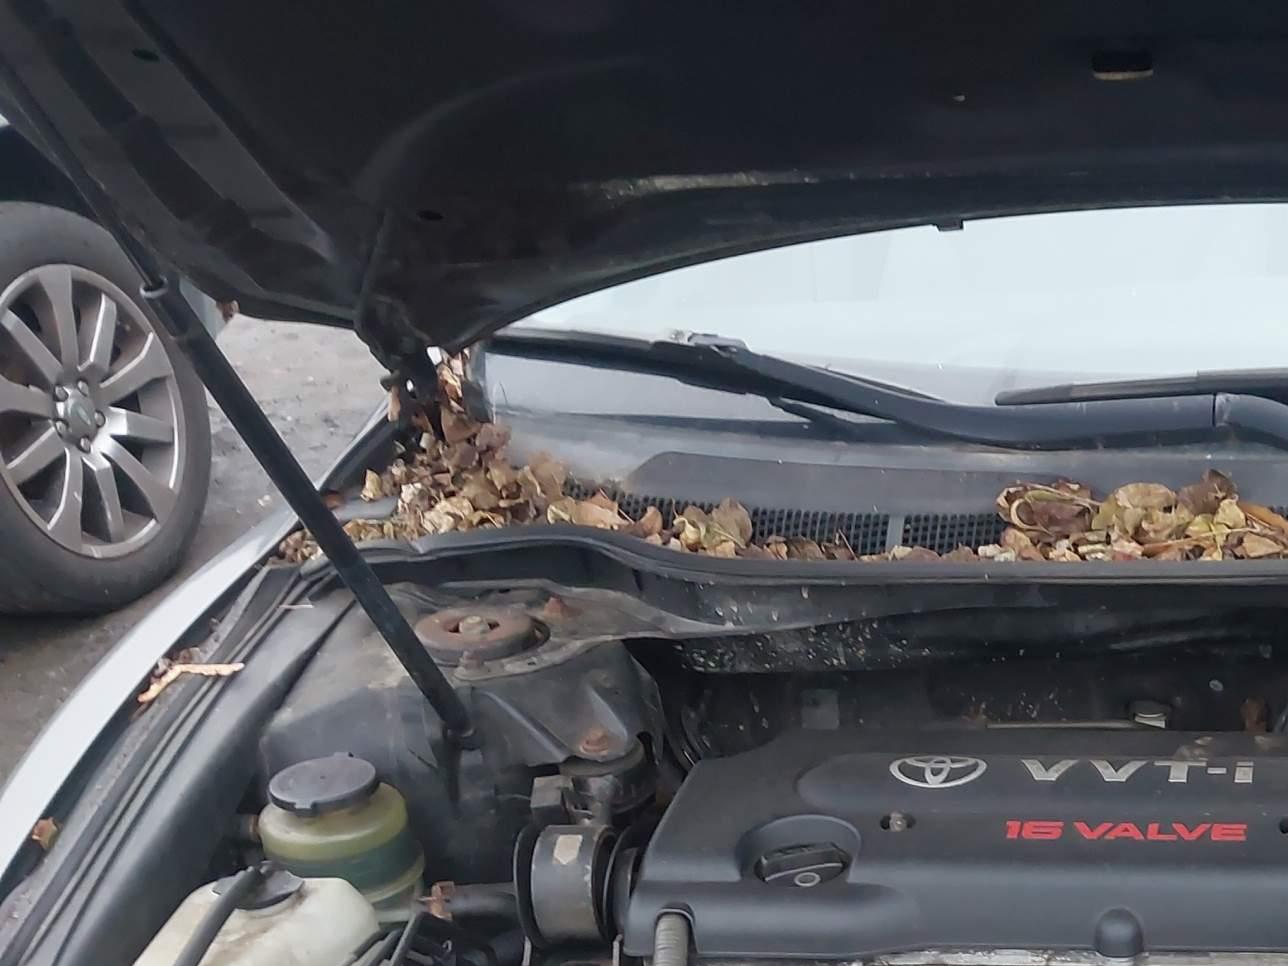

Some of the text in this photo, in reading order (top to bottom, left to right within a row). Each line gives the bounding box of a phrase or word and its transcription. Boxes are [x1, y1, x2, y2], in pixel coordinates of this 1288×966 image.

[1020, 759, 1255, 784] VVT-i
[1006, 820, 1249, 842] 16 VALVE
